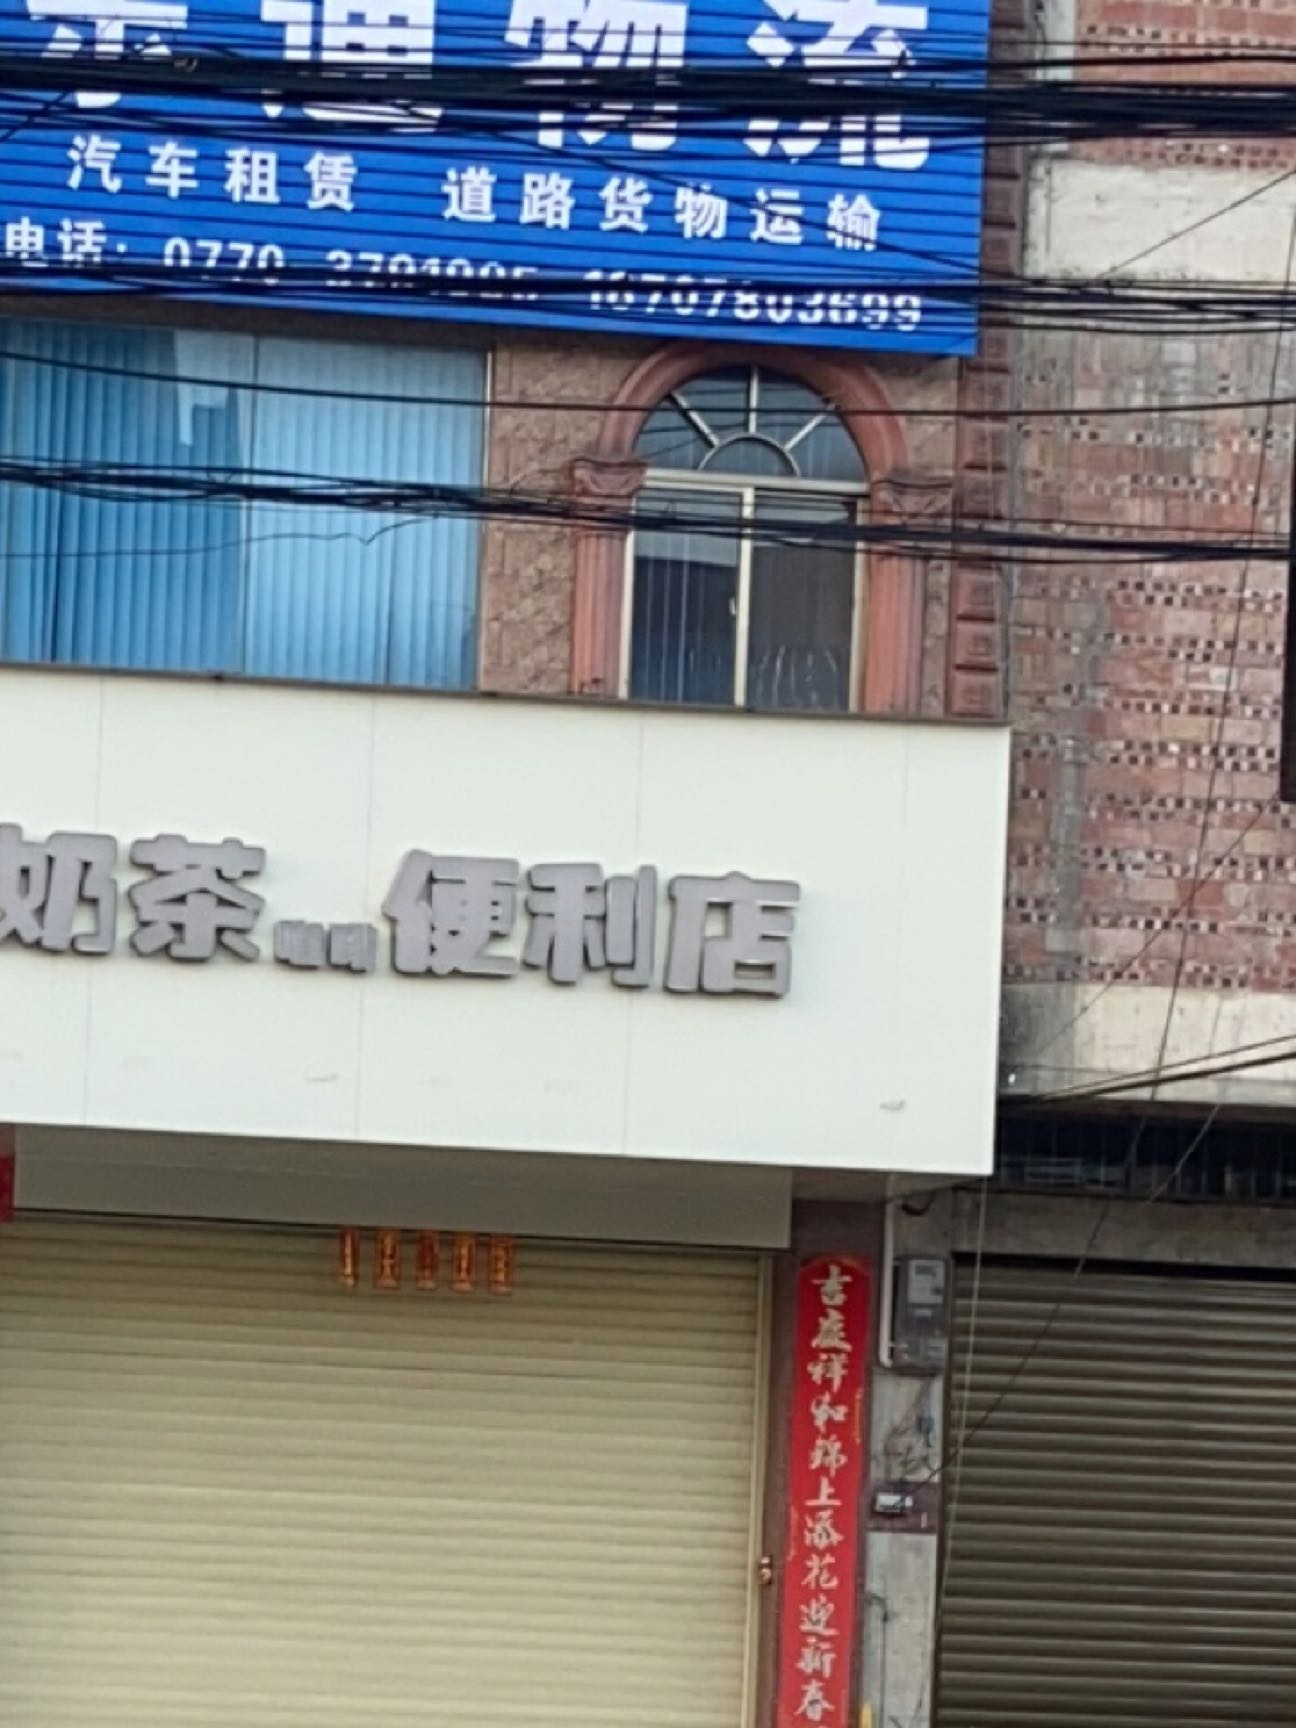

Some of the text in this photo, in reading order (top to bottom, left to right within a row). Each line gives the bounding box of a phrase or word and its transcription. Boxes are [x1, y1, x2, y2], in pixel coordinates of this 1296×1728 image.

[67, 135, 881, 251] 汽车租赁 道路货物运输
